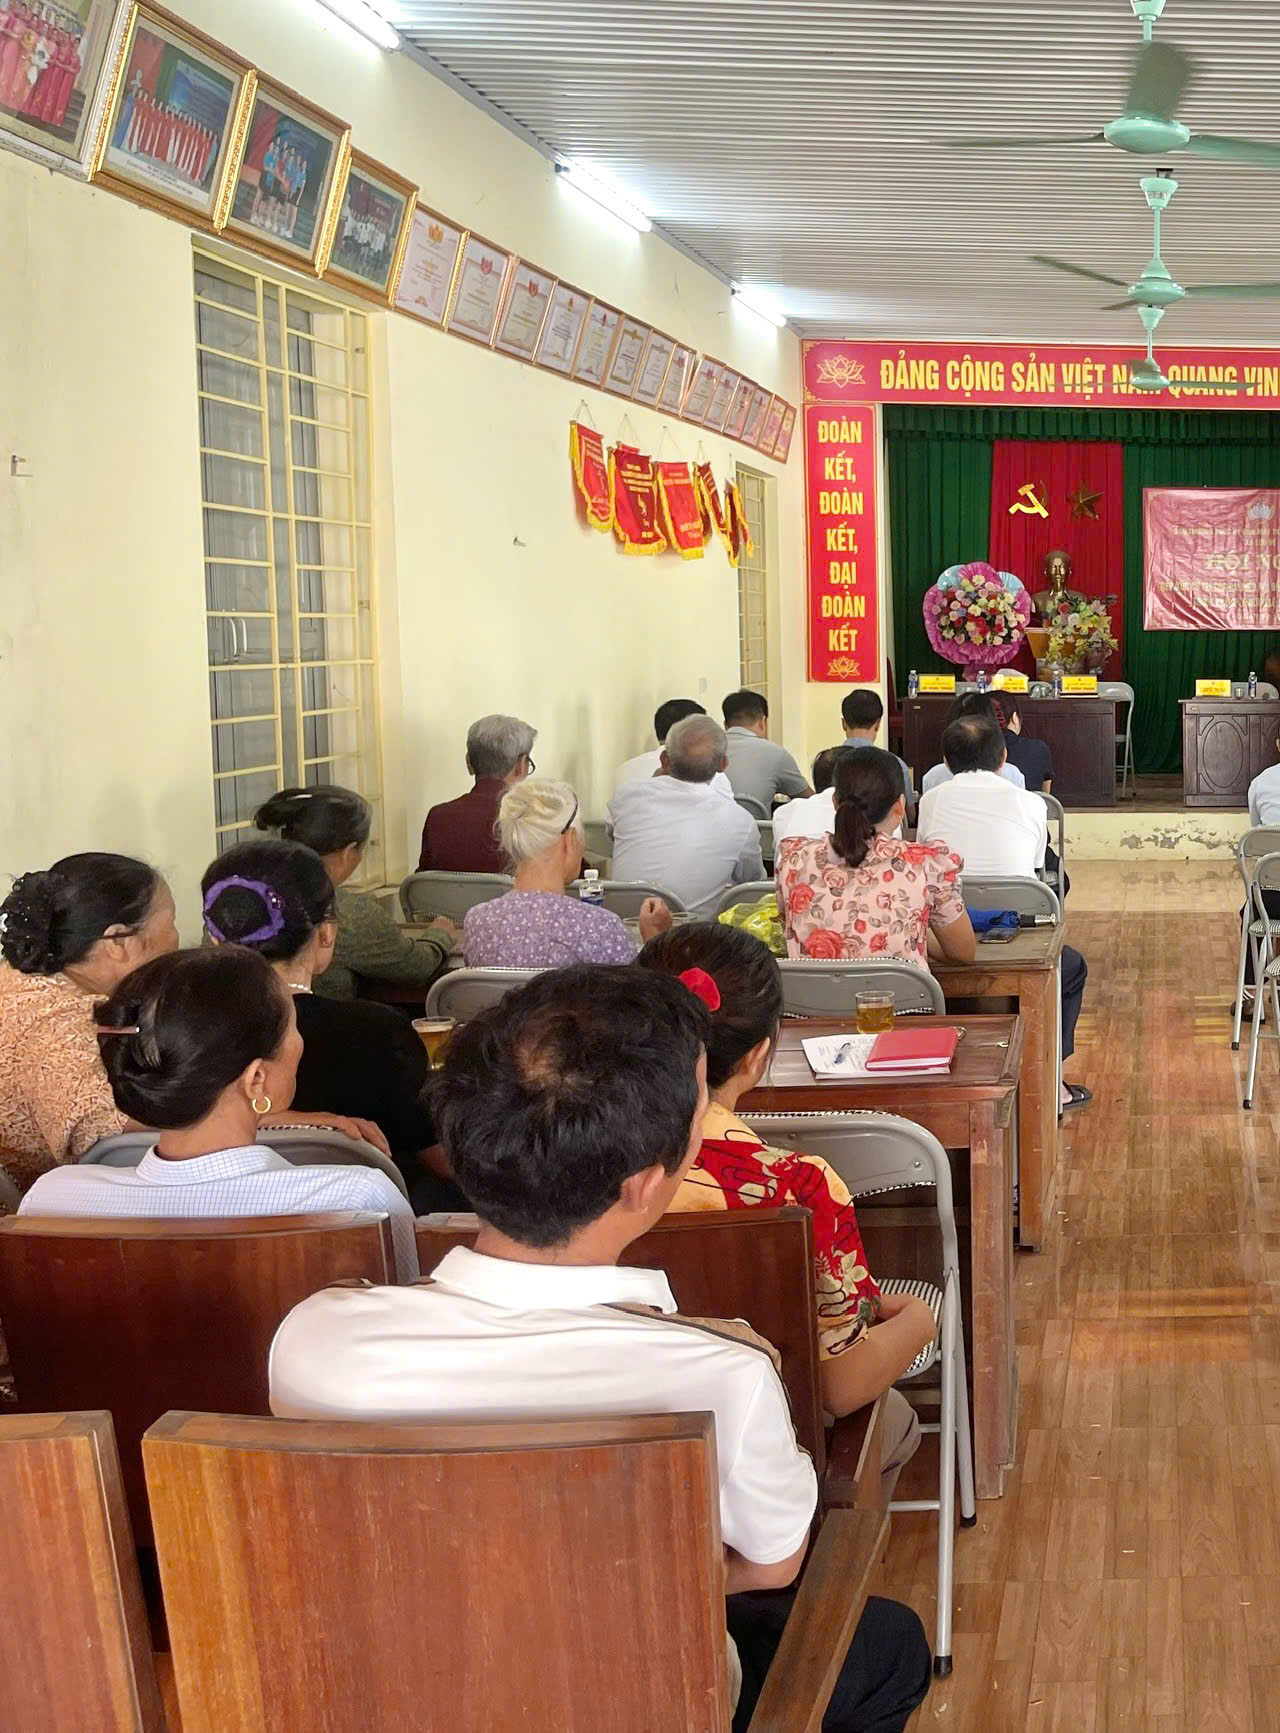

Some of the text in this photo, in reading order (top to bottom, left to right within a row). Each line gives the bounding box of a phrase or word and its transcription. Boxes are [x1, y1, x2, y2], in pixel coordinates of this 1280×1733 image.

[880, 350, 939, 390] ĐẢNG
[946, 354, 1005, 397] CỘNG
[1011, 352, 1056, 392] SẢN
[1062, 357, 1106, 400] VIỆT
[1168, 365, 1238, 399] QUANG
[818, 416, 862, 443] ĐOÀN
[824, 450, 857, 483] KẾT,
[819, 487, 864, 515] ĐOÀN
[826, 521, 858, 554] KẾT,
[829, 561, 857, 589] ĐẠI
[821, 590, 866, 618] ĐOÀN
[828, 622, 858, 652] KẾT
